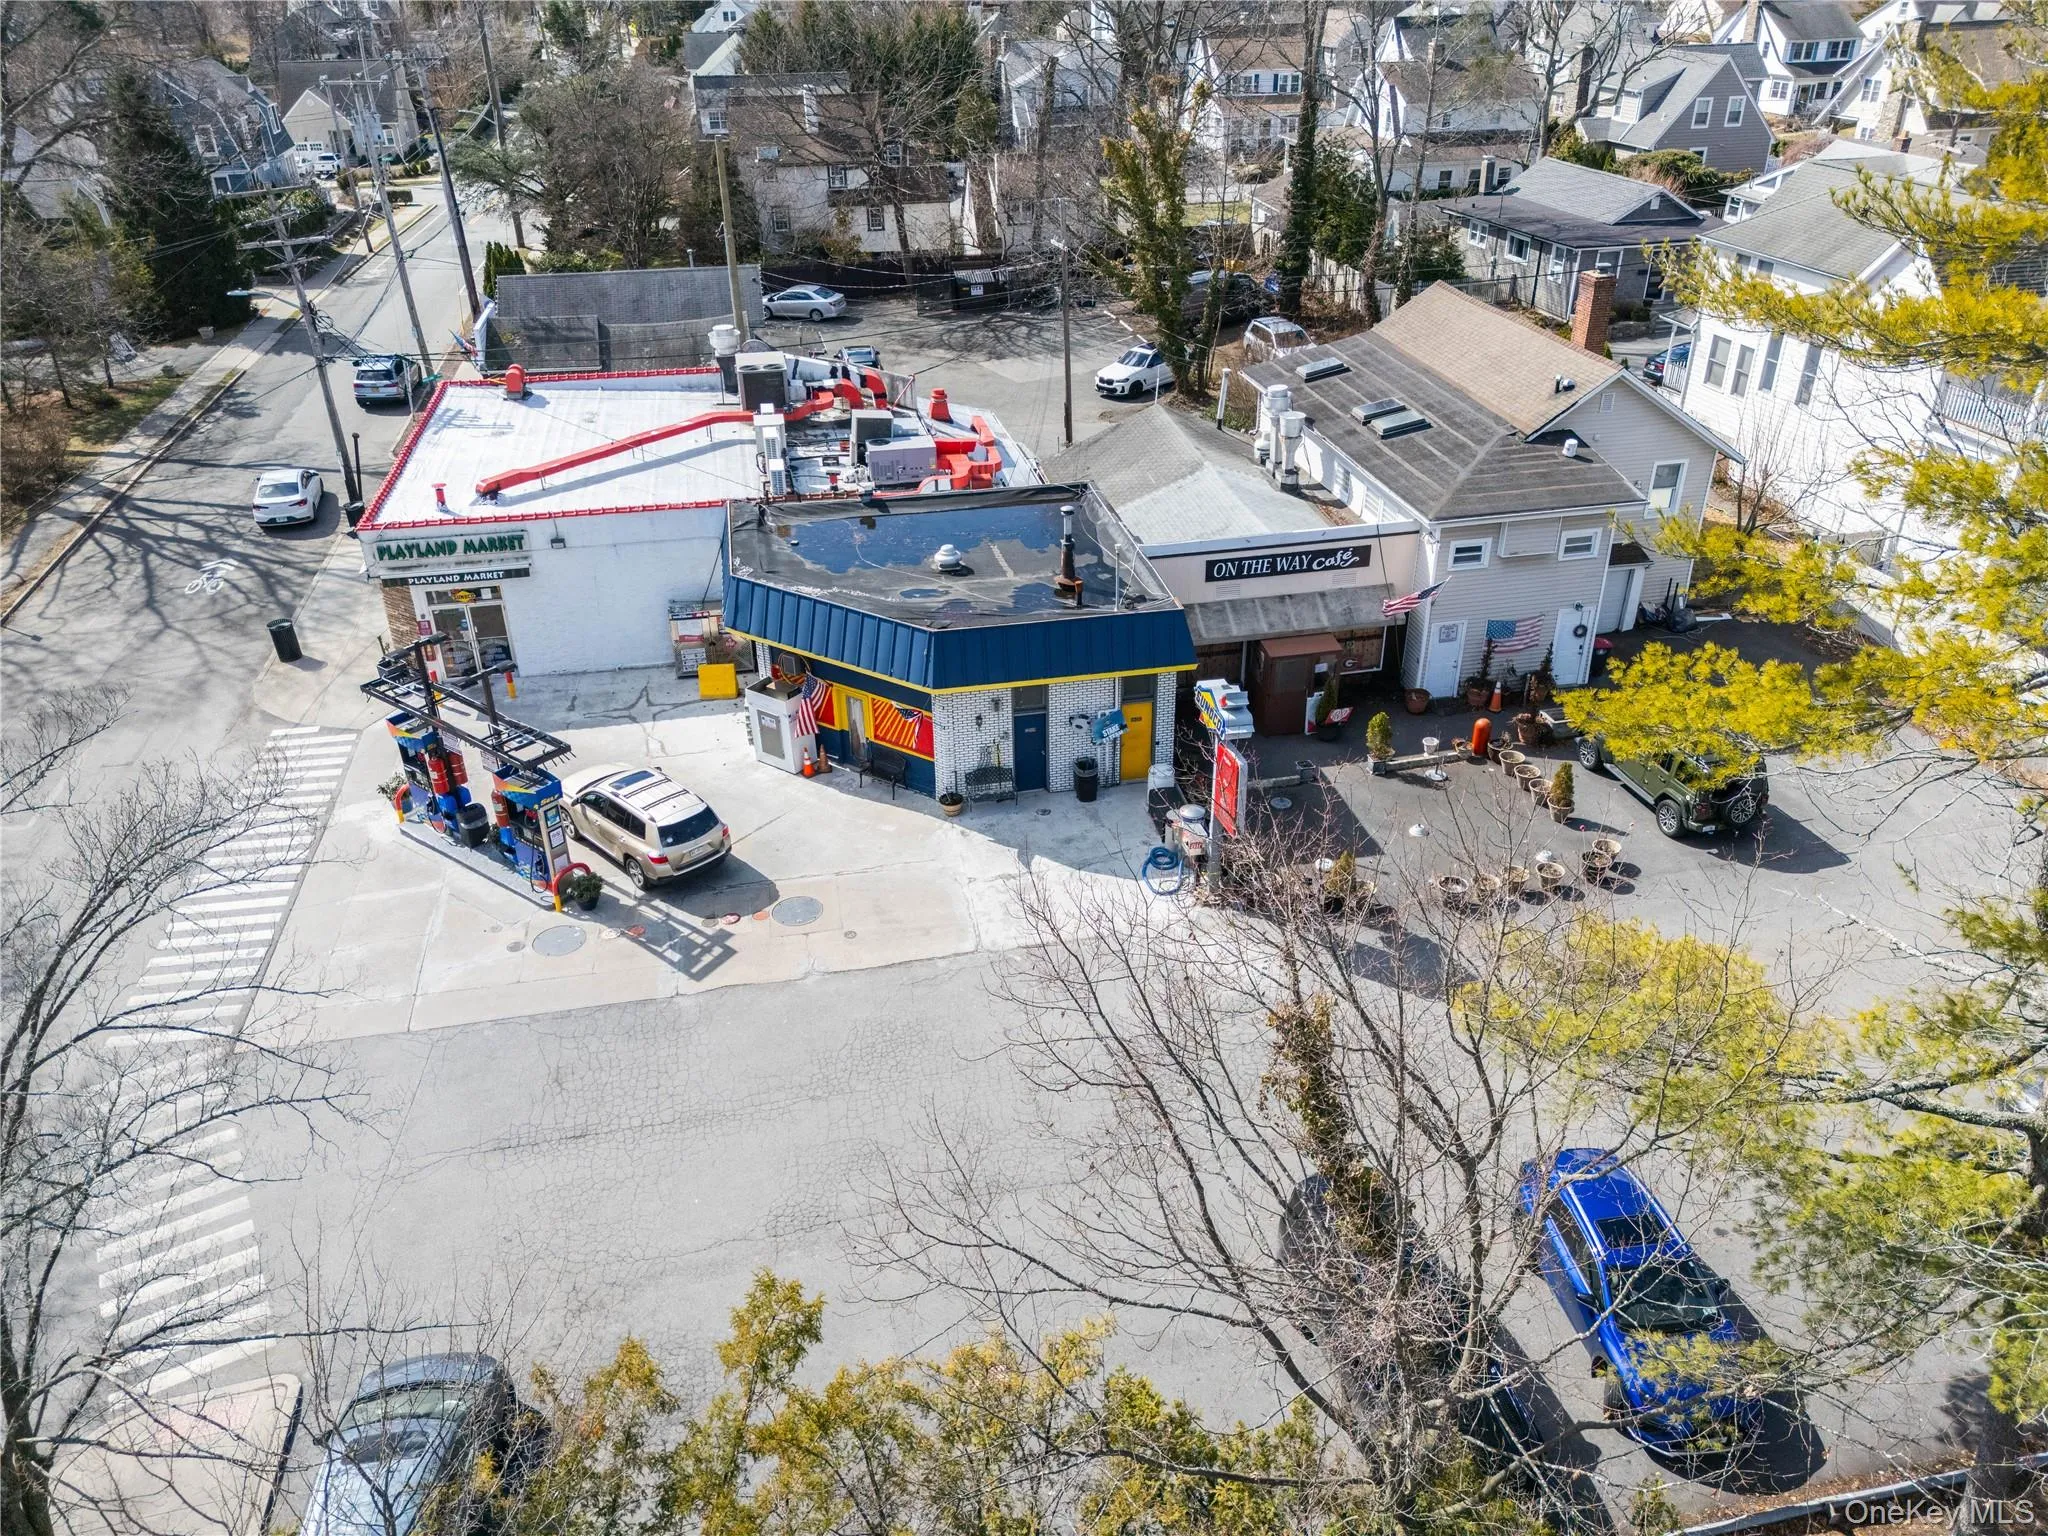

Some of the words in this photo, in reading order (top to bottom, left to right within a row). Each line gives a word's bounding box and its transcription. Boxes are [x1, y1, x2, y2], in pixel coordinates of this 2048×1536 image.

[377, 540, 458, 561] PLAYLAND
[463, 534, 525, 555] MARKET
[1213, 562, 1238, 578] ON
[1241, 558, 1273, 576] THE
[1276, 554, 1312, 572] WAY
[1312, 547, 1360, 571] Café
[408, 574, 460, 586] PLAYLAND
[463, 570, 505, 582] MARKET
[1195, 689, 1223, 733] SUNOCO
